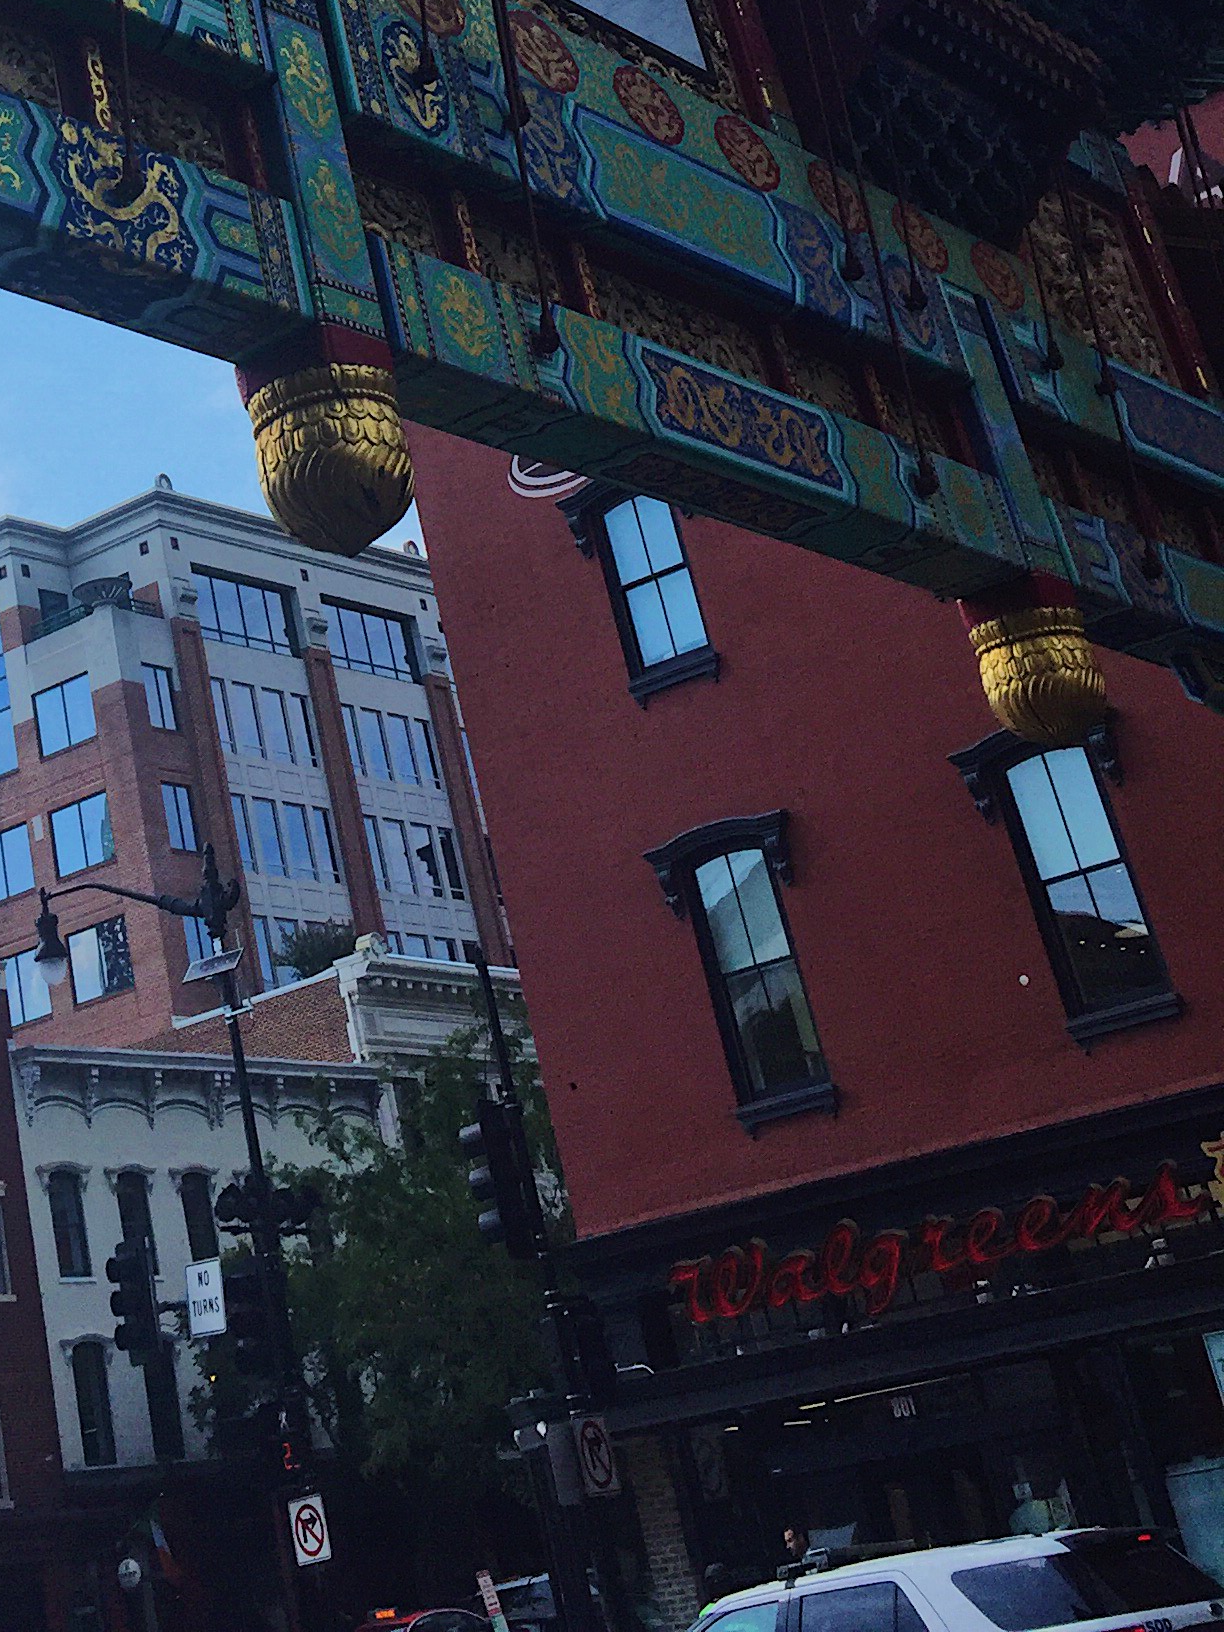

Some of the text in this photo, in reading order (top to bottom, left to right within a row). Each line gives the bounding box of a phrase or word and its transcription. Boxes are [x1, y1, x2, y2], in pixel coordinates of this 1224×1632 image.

[669, 1160, 1212, 1324] Walgreens
[197, 1269, 210, 1287] NO
[192, 1296, 220, 1317] TURNS
